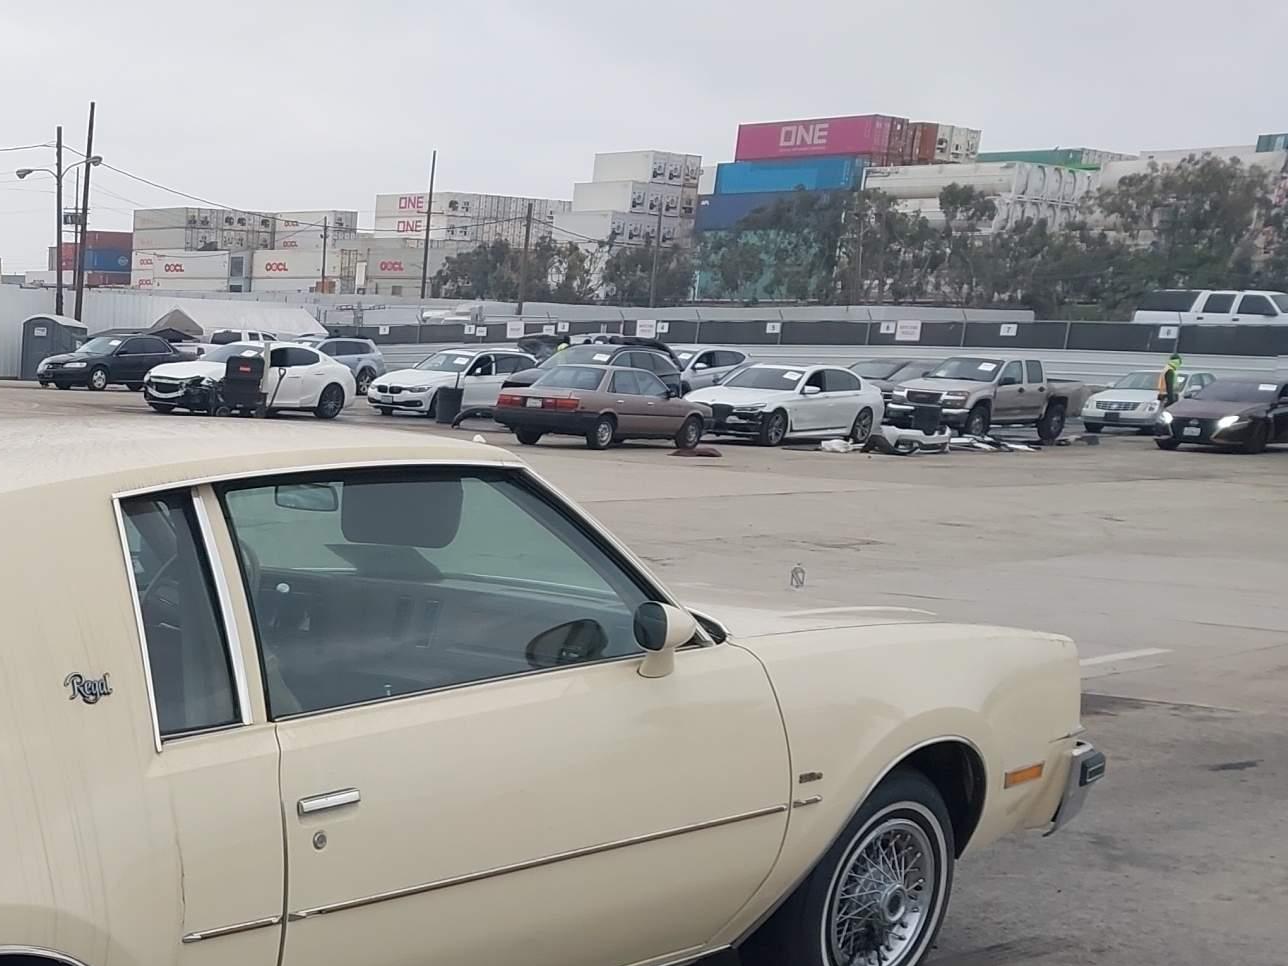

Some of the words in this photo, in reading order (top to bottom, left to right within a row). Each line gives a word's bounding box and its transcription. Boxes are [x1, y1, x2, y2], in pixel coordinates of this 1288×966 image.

[779, 123, 829, 146] ONE
[398, 195, 424, 209] ONE
[397, 220, 422, 232] ONE
[164, 263, 185, 273] OOCL
[265, 262, 288, 272] OOCL
[379, 261, 404, 271] OOCL
[63, 672, 114, 705] Regal
